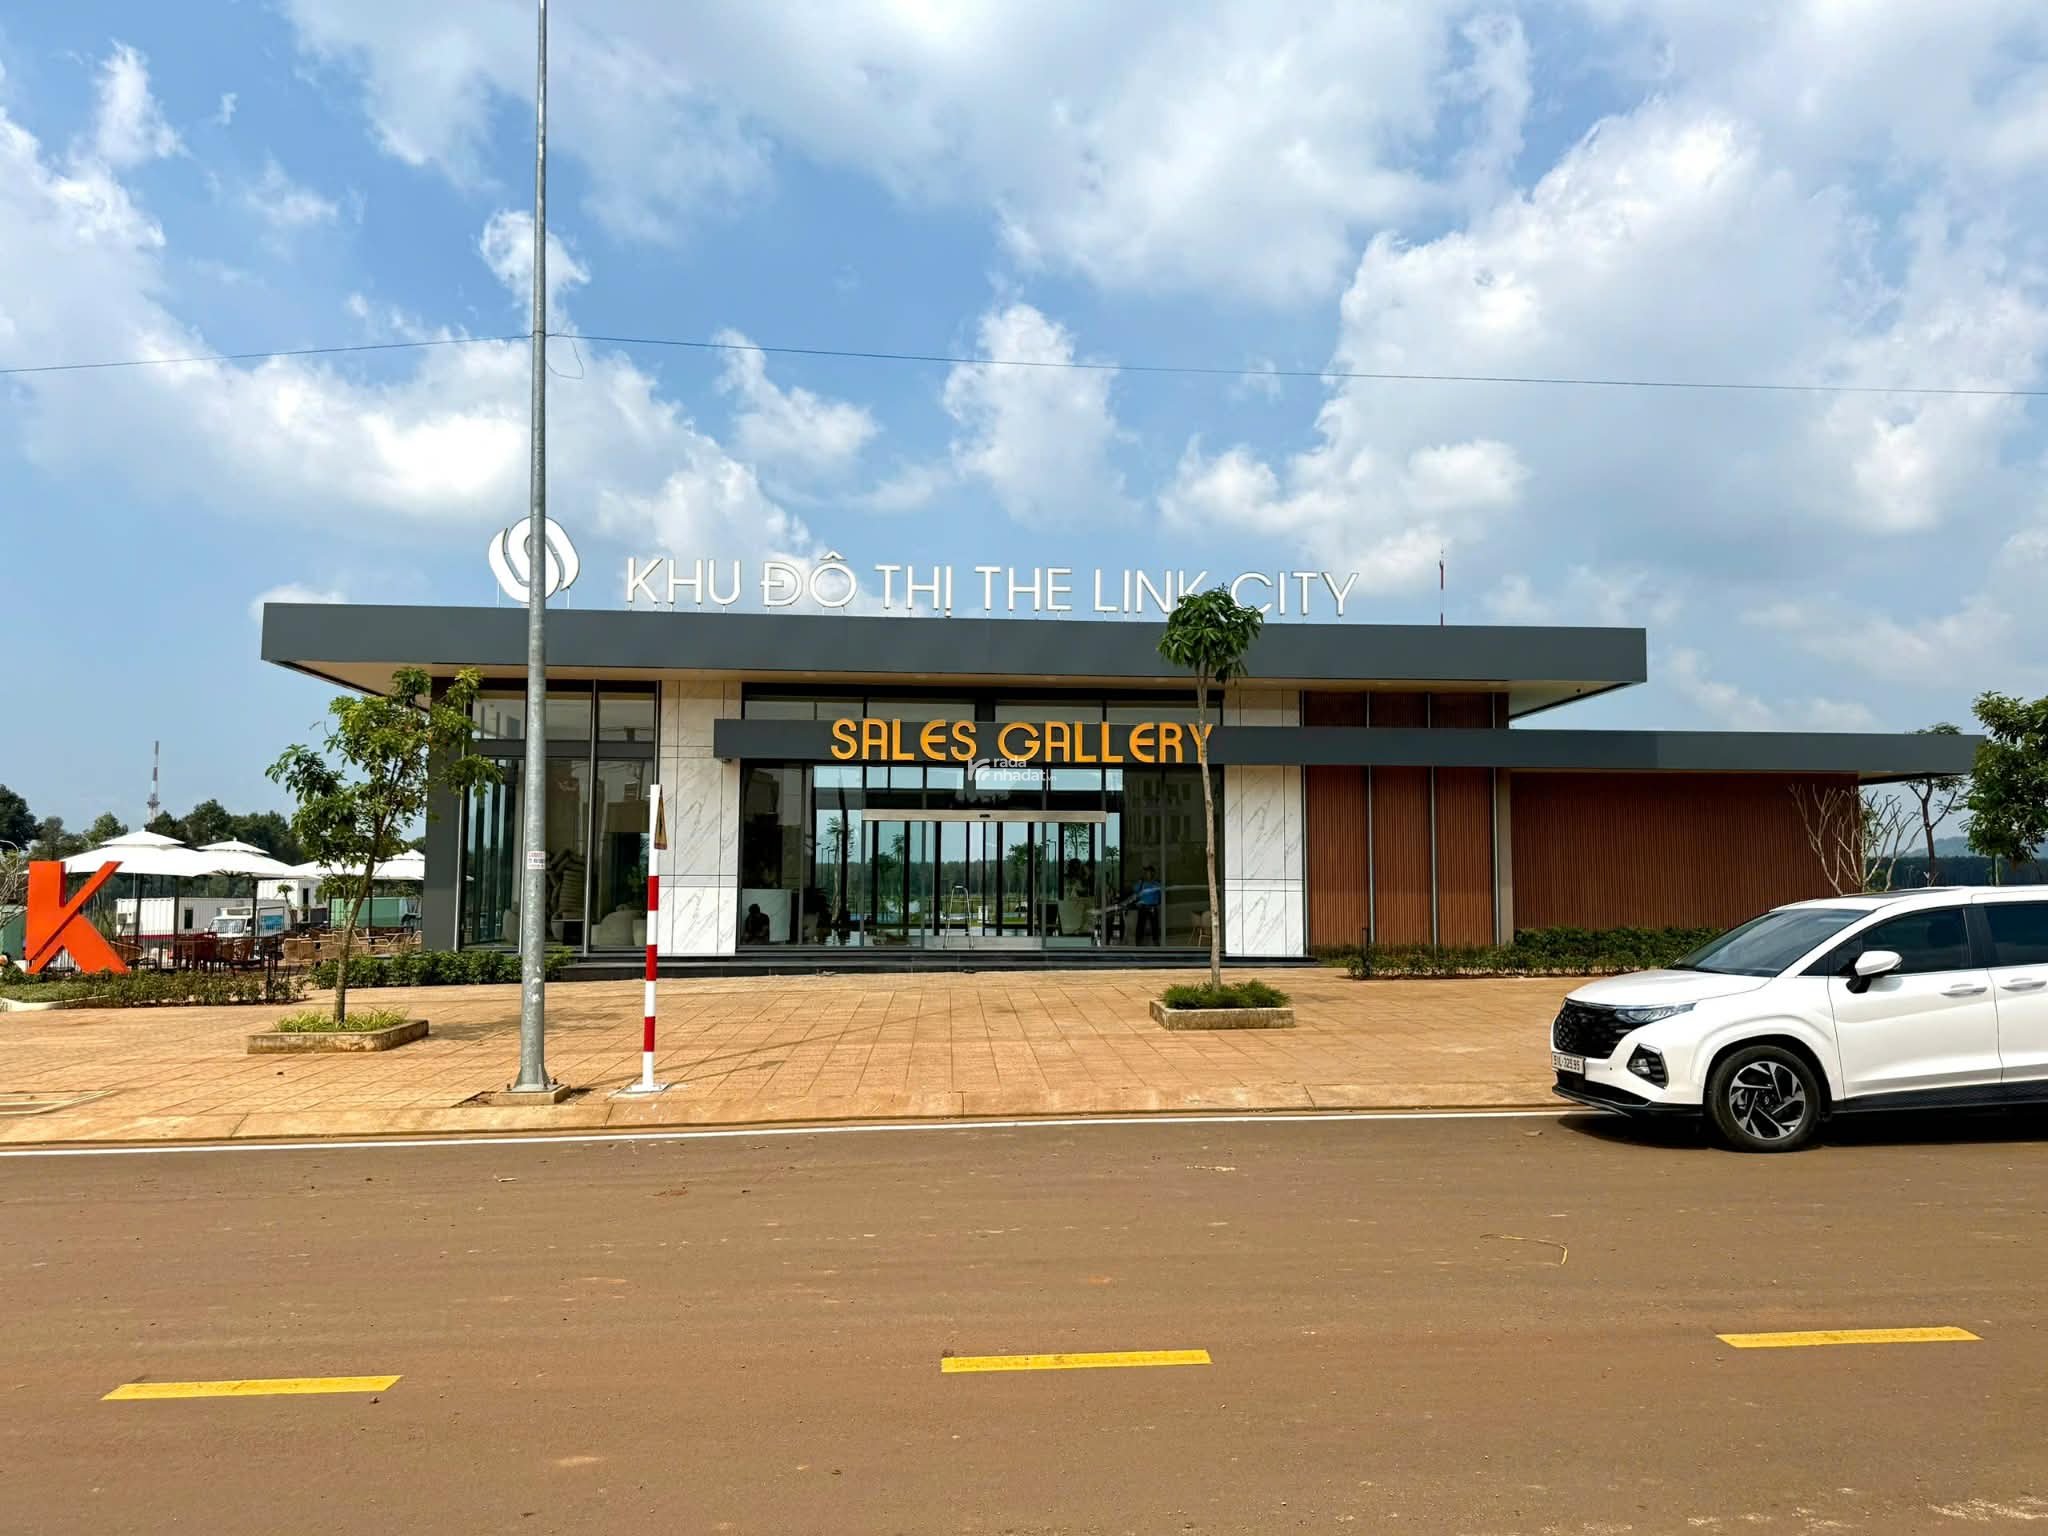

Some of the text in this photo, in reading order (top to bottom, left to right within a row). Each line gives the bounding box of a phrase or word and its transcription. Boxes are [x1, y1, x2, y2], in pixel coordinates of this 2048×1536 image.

[626, 550, 1360, 618] KHU ĐÔ THỊ THE LINK CITY
[830, 718, 1214, 764] SALES GALLERY
[24, 861, 130, 975] K
